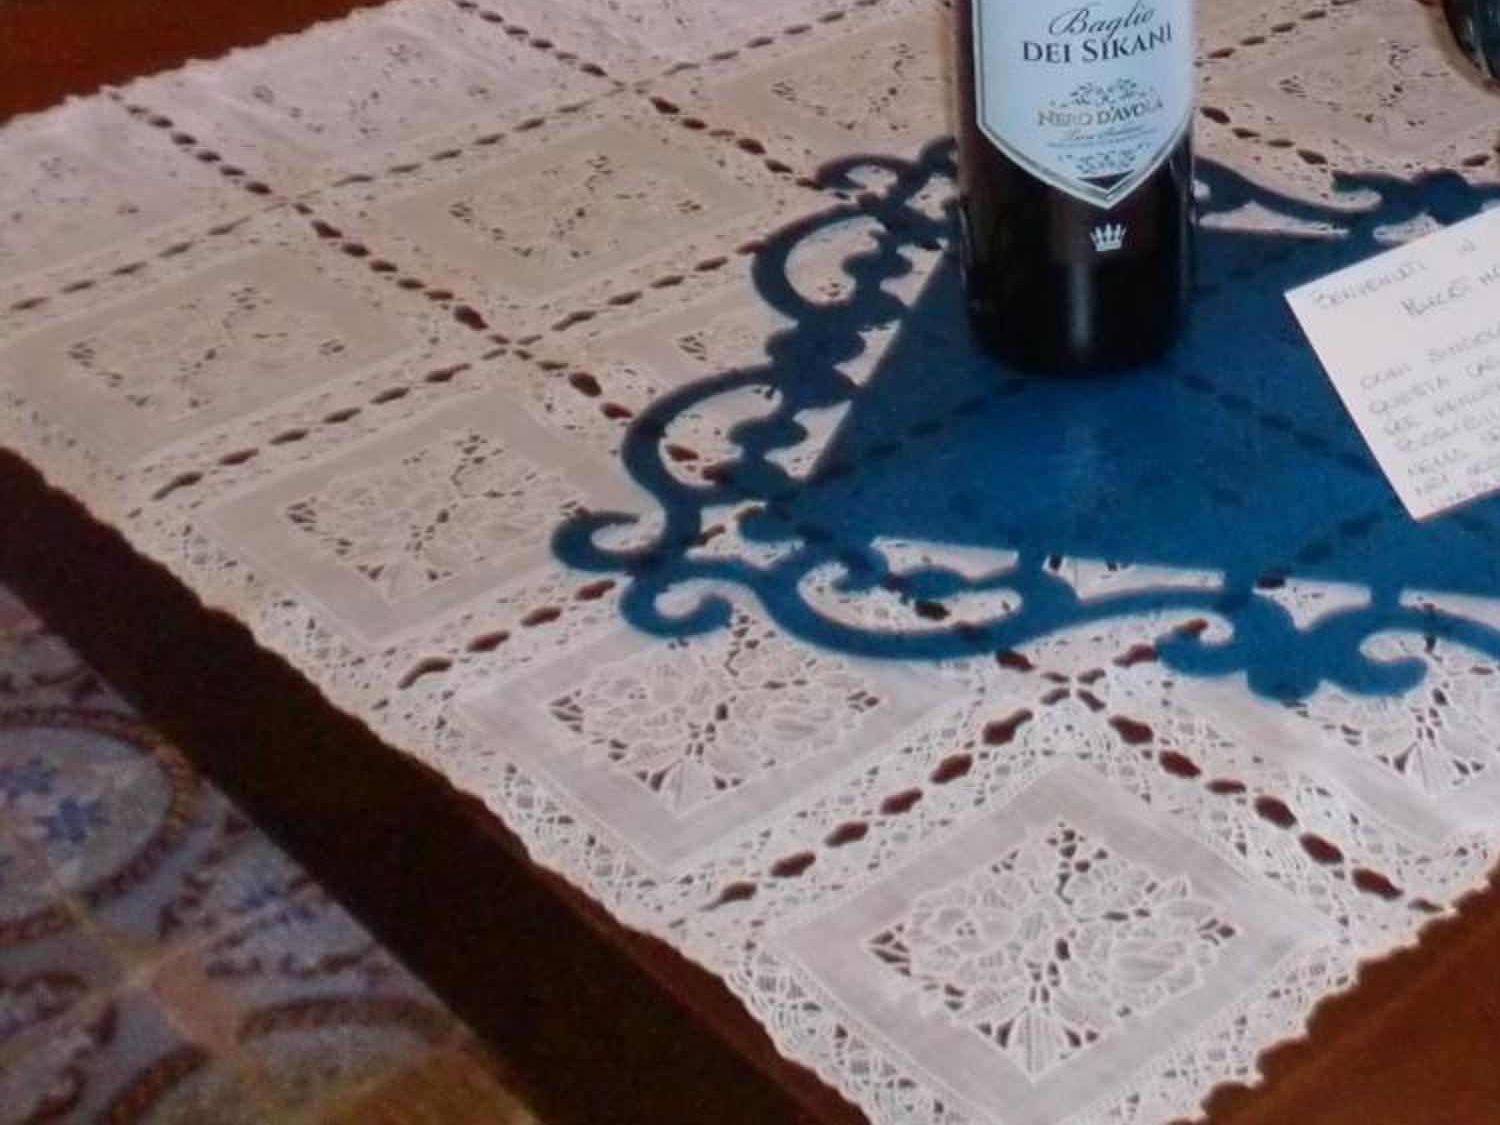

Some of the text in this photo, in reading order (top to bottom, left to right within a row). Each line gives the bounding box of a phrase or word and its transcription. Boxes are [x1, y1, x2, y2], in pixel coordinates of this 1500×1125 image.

[1022, 24, 1173, 64] DEI SIKANI
[1038, 107, 1092, 126] NERO
